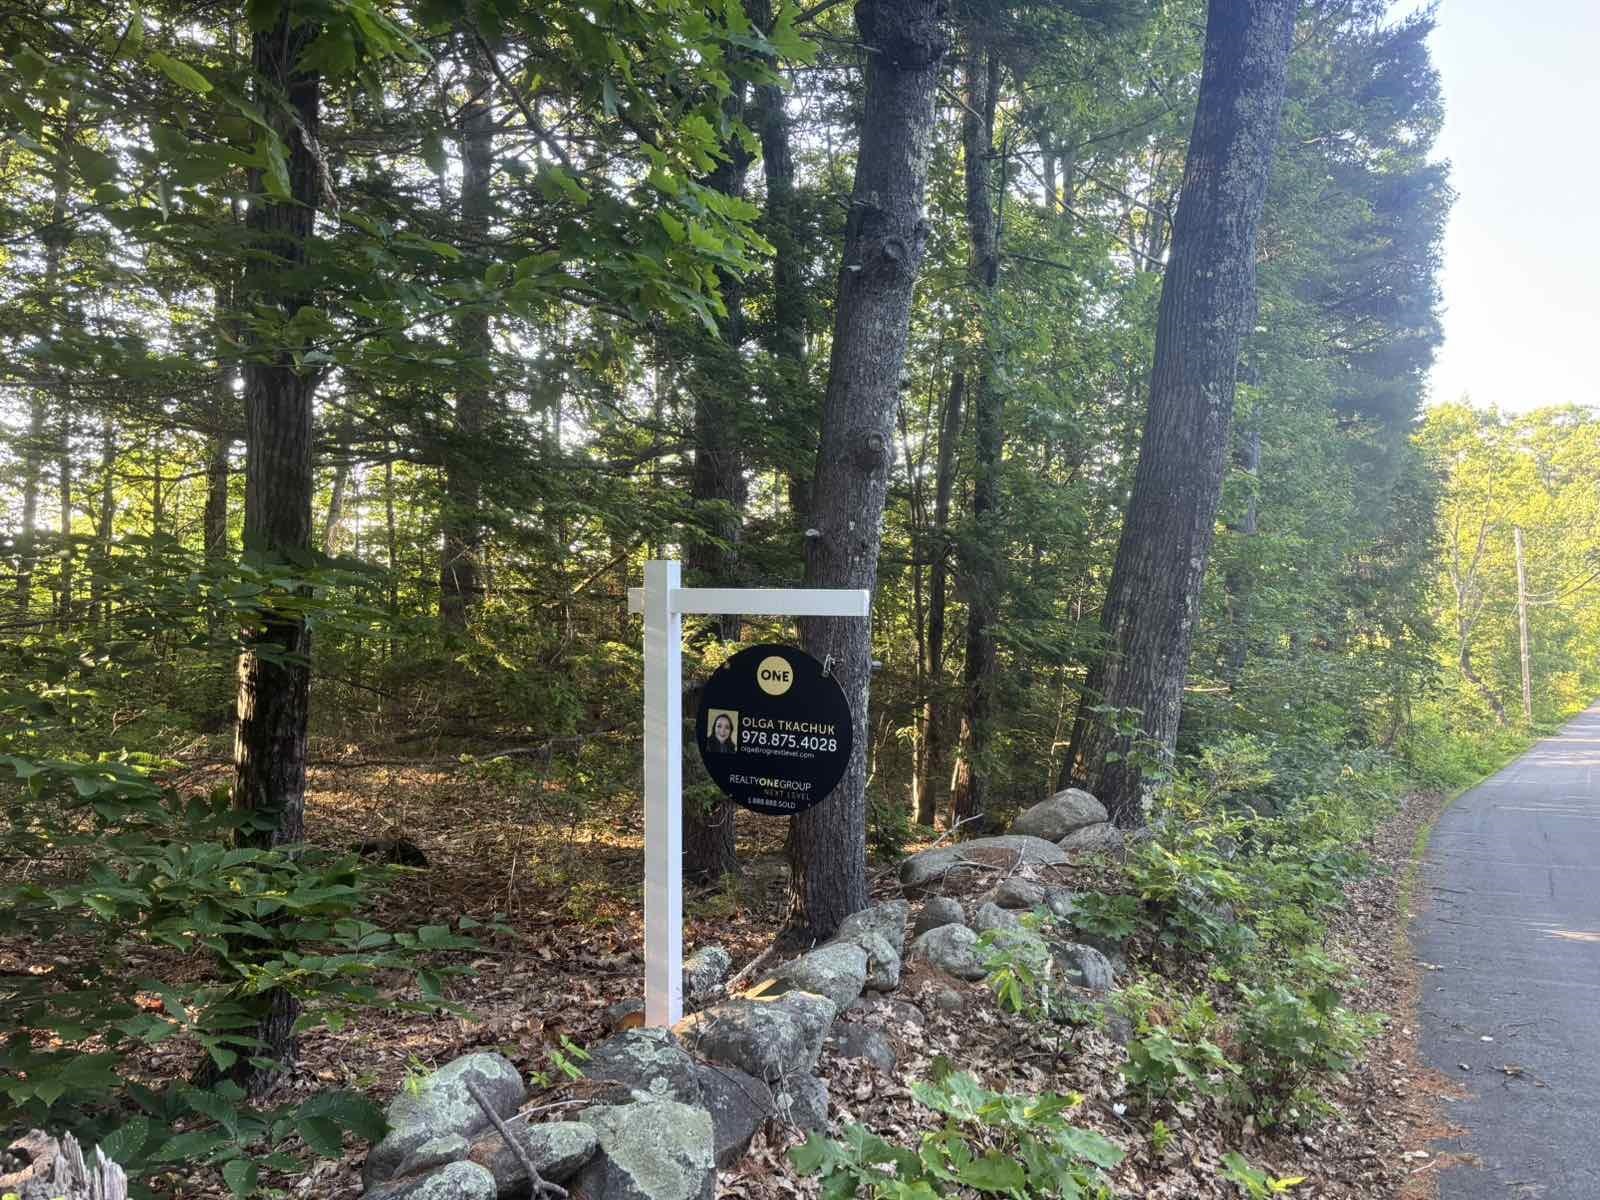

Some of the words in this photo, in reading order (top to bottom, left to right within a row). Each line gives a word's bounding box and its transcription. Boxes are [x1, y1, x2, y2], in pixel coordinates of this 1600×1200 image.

[761, 669, 790, 682] ONE
[742, 716, 775, 729] OLGA
[779, 720, 835, 735] TKACHUK
[741, 730, 837, 752] 978.875.4028
